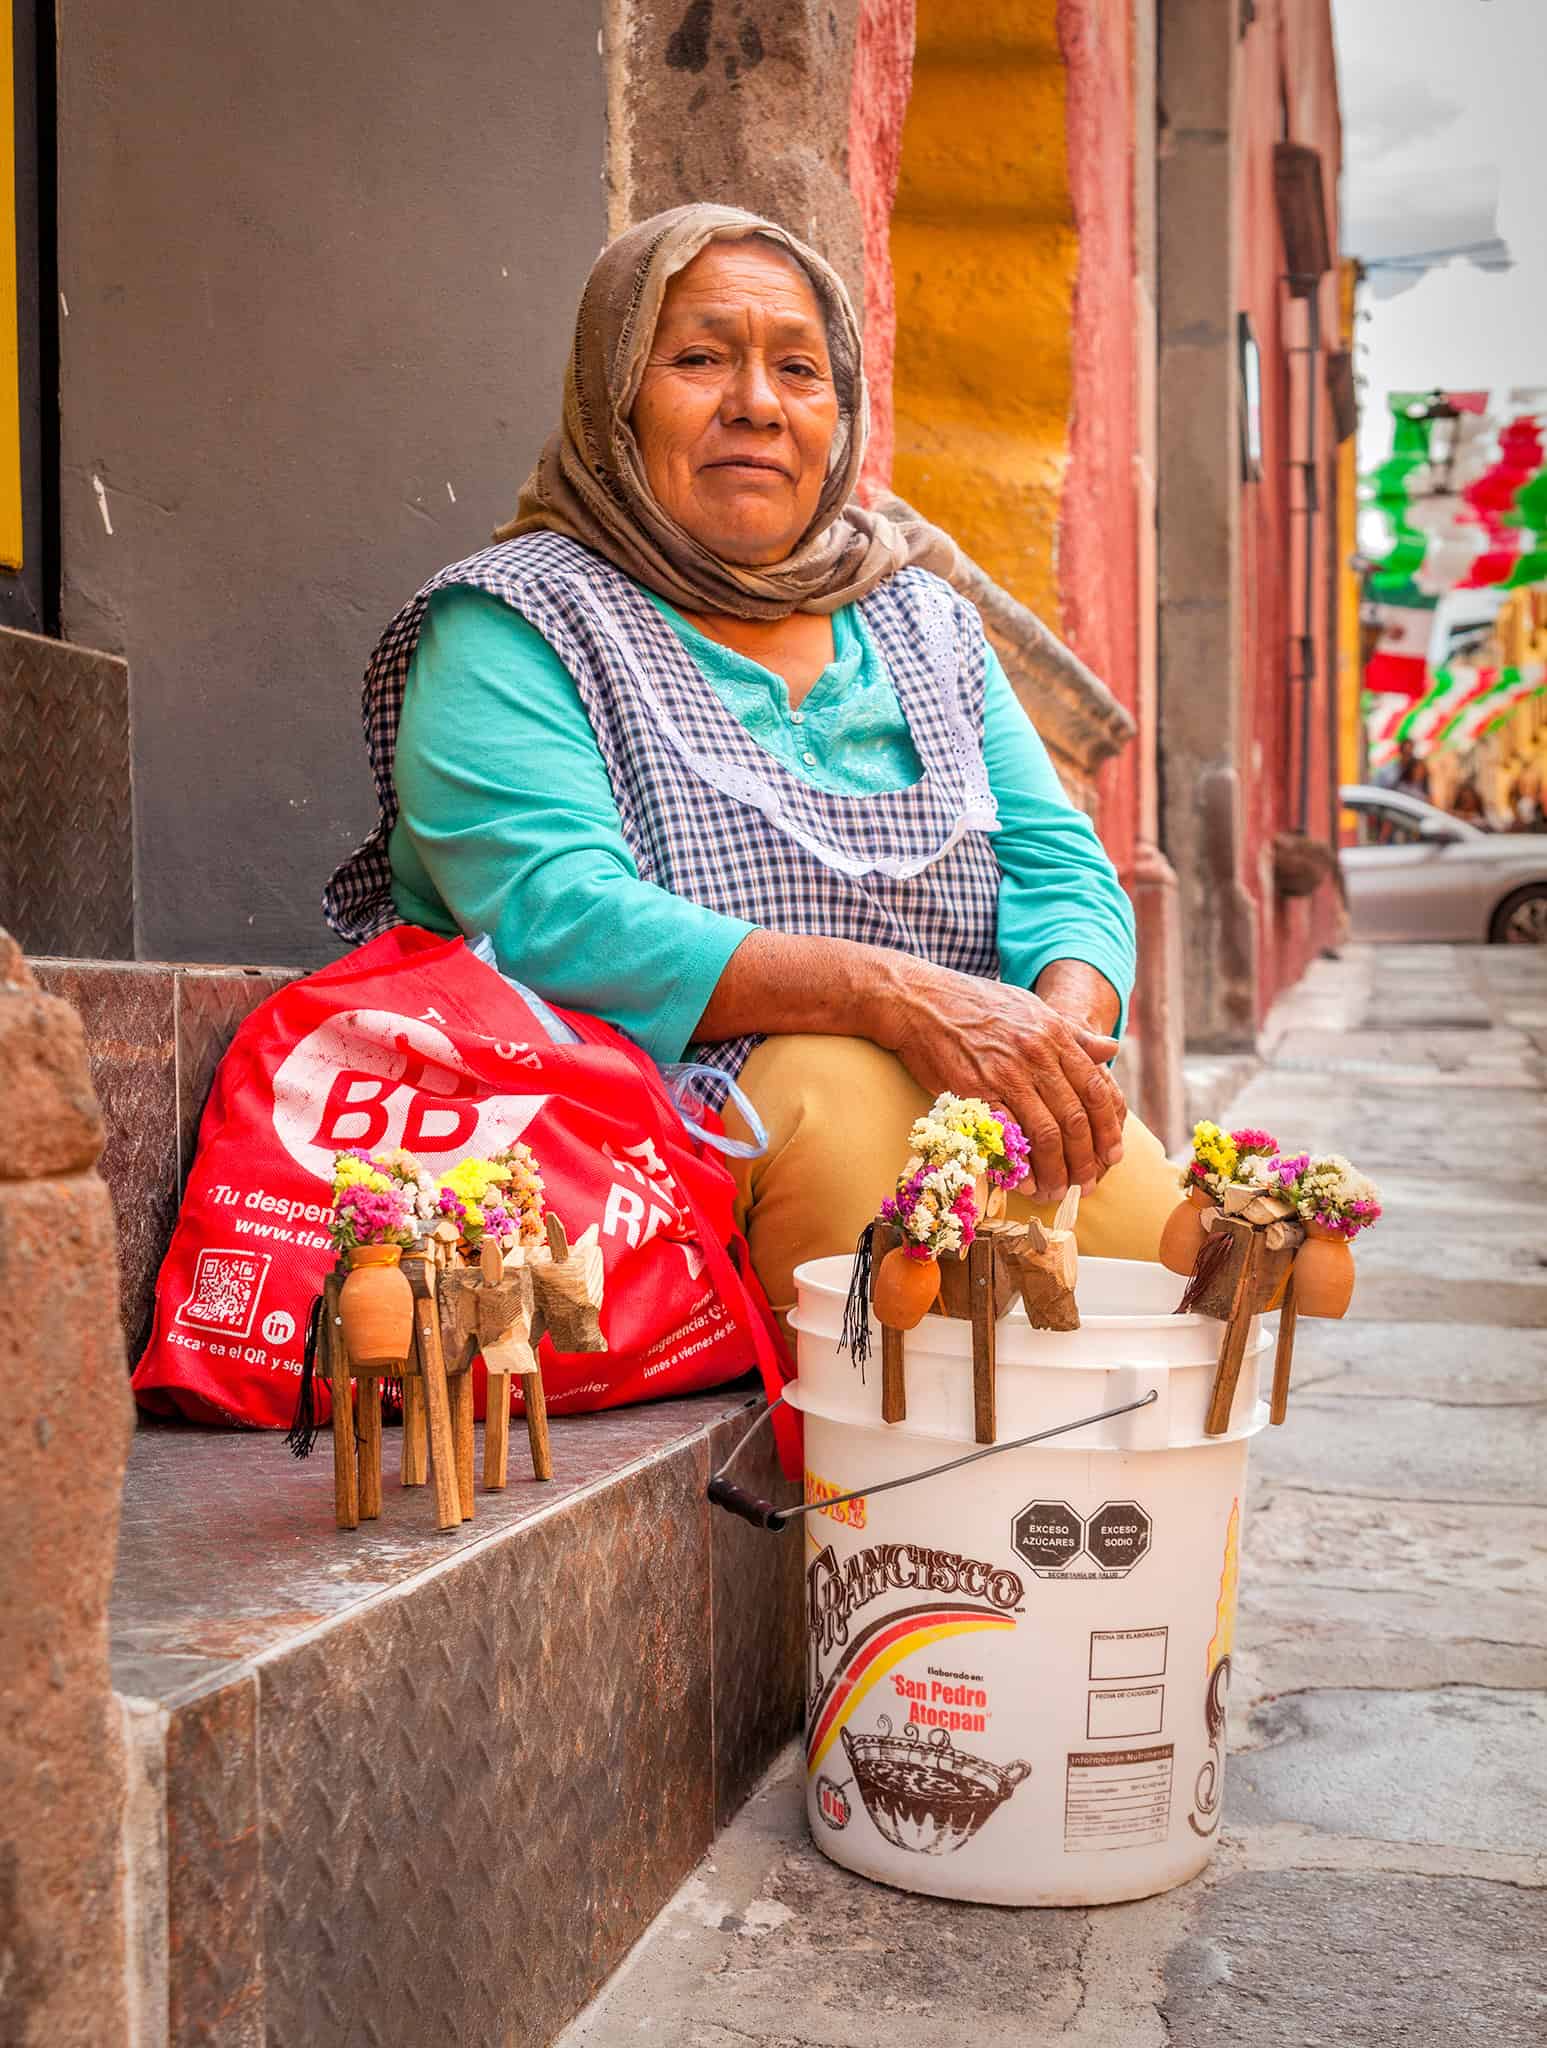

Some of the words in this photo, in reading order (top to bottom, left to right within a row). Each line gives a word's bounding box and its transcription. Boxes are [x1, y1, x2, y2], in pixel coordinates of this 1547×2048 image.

[244, 1189, 341, 1225] despen
[167, 1332, 225, 1356] Escaea
[244, 1347, 267, 1365] QR
[1029, 1525, 1069, 1535] EXCESO
[1100, 1525, 1137, 1535] EXCESO
[1104, 1537, 1134, 1547] SODIO
[927, 1667, 970, 1680] Elaborado
[931, 1681, 987, 1708] Pedro
